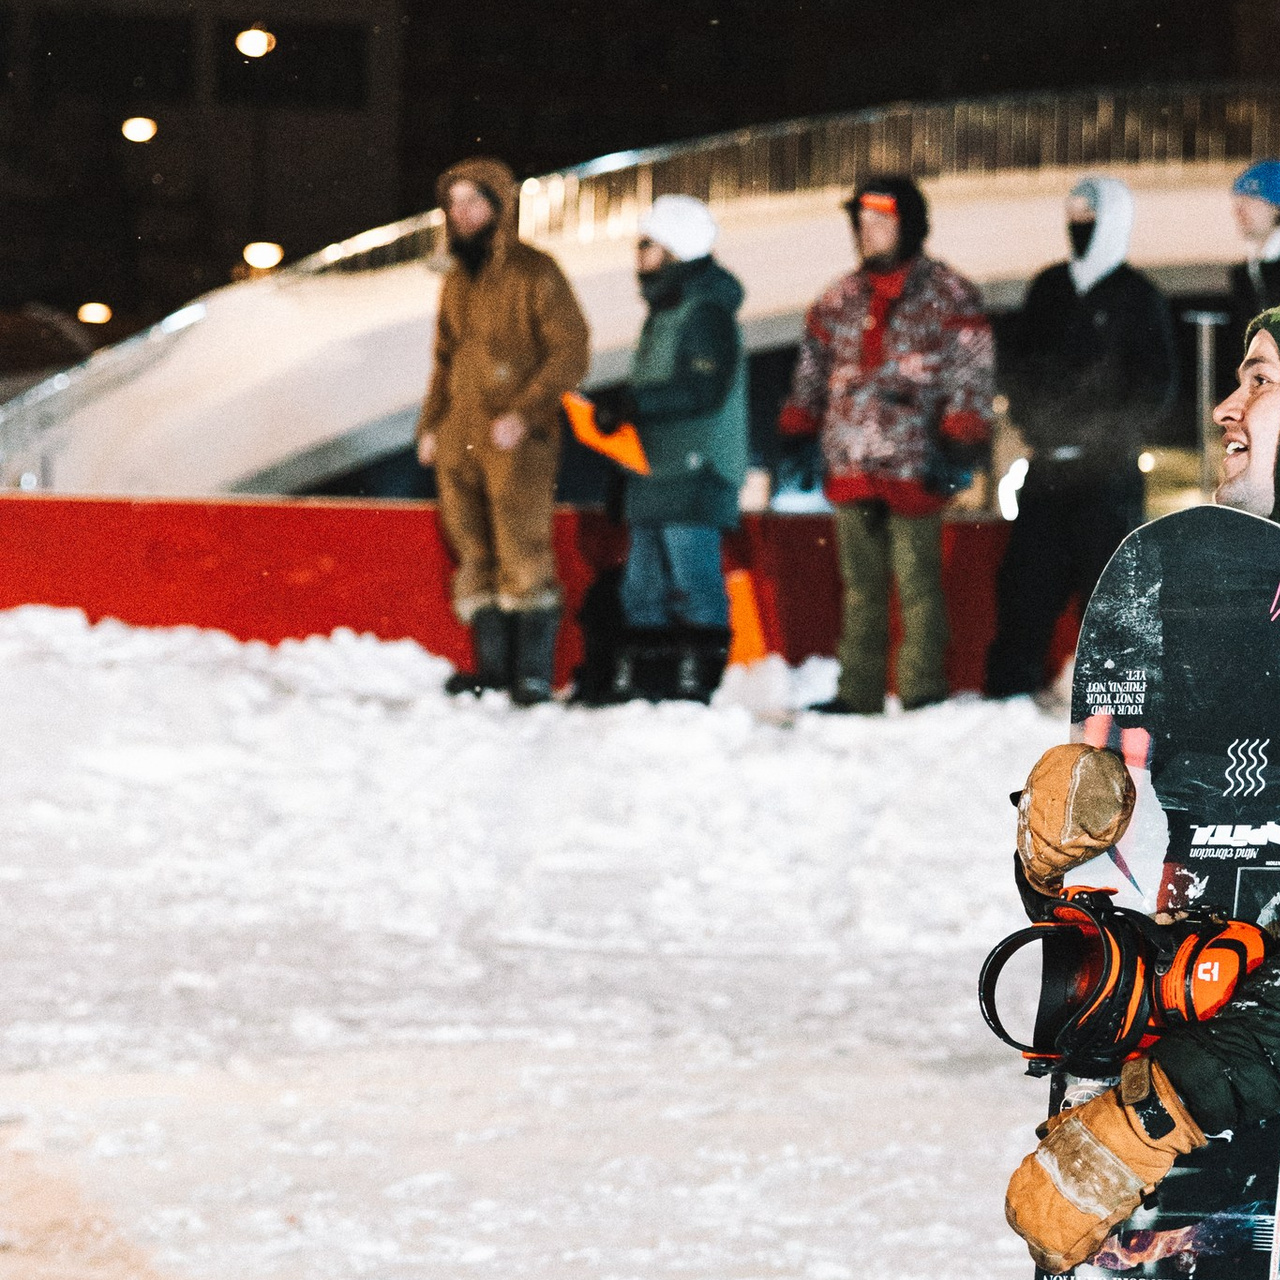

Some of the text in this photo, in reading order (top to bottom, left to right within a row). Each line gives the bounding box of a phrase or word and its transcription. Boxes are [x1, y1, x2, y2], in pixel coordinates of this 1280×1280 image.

[1125, 670, 1147, 680] YET.
[1085, 680, 1147, 692] FRIEND, NOT
[1085, 693, 1145, 704] IS NOT YOUR
[1091, 704, 1144, 715] YOUR MIND
